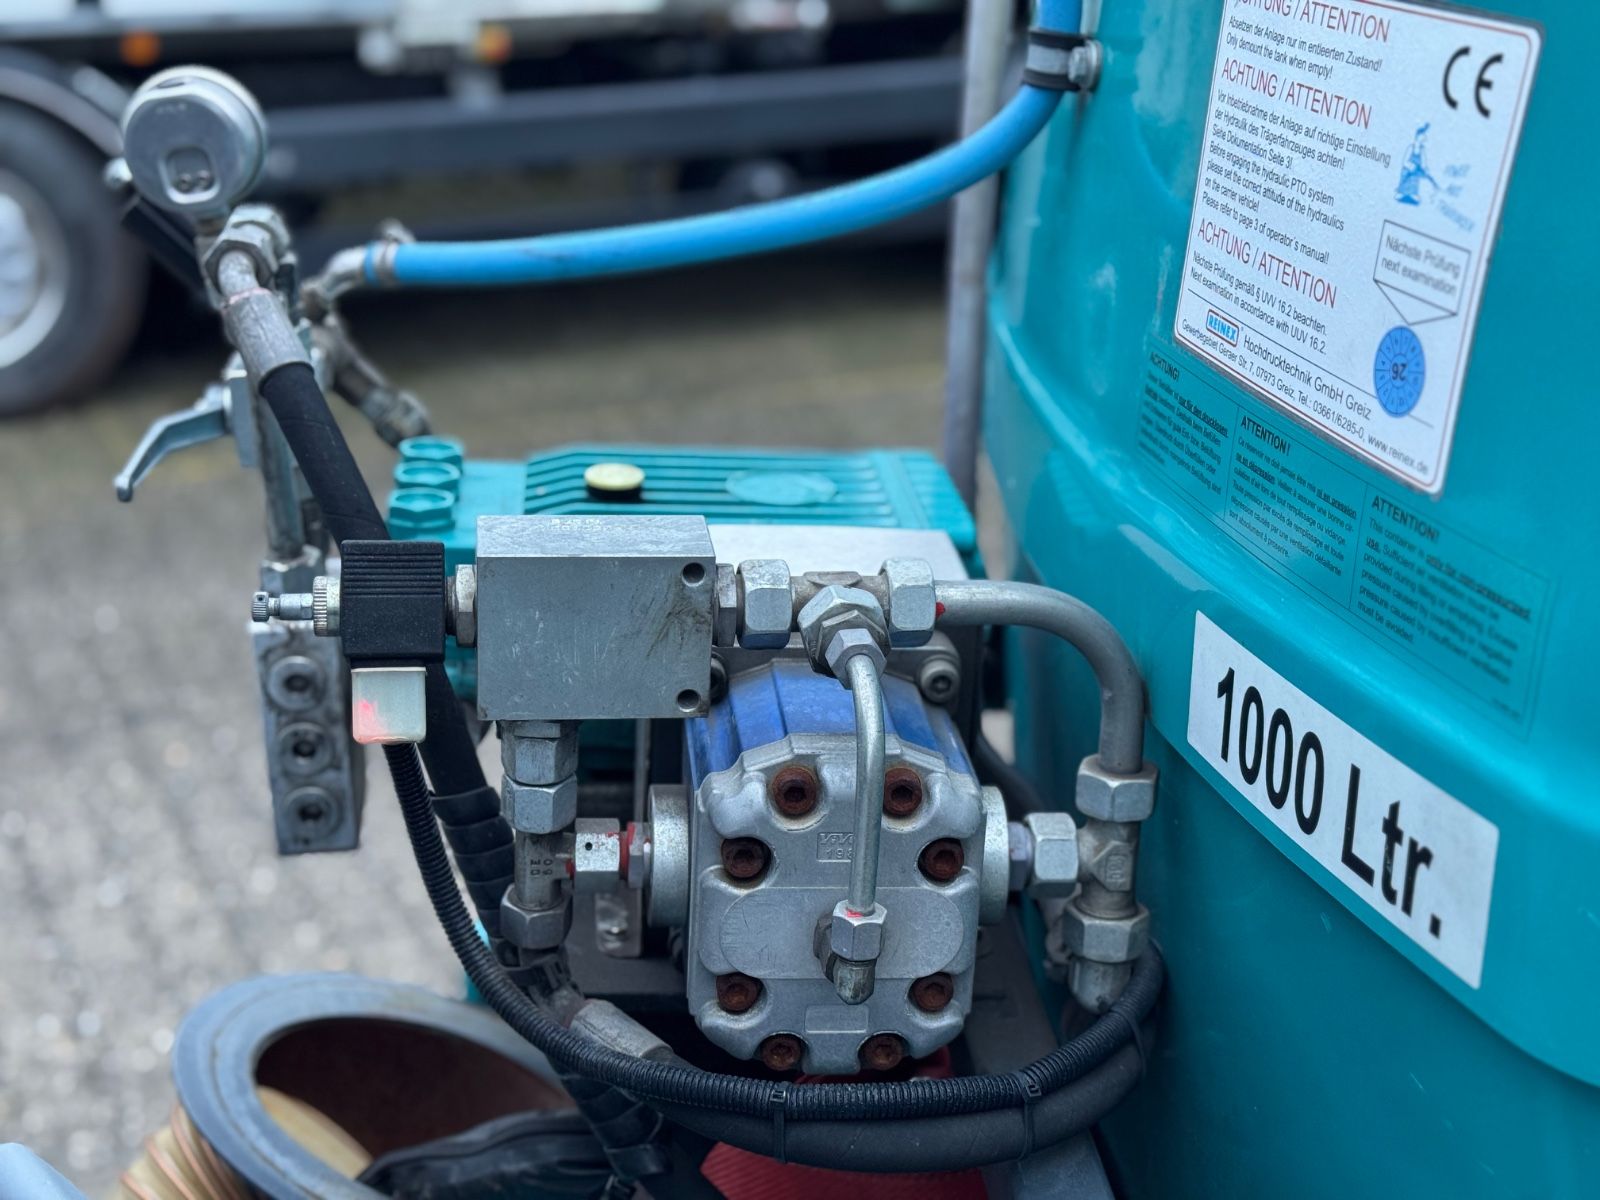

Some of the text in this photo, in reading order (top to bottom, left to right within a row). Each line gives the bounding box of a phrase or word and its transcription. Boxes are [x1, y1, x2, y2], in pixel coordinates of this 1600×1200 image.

[1229, 16, 1382, 72] Absetzen der Anlage nur im entleerten Zustand!
[1294, 0, 1301, 20] /
[1300, 0, 1391, 42] ATTENTION
[1226, 33, 1238, 51] Only
[1263, 46, 1273, 59] the
[1274, 50, 1288, 64] tank
[1289, 56, 1307, 70] when
[1308, 63, 1333, 81] empty!
[1442, 46, 1504, 118] CE
[1222, 57, 1372, 130] ACHTUNG / ATTENTION
[1215, 107, 1346, 170] der Hydraulik des Trägerfahrzeuges achten!
[1217, 90, 1391, 169] Vor Inbetriebnahme der Anlage auf richtige Einstellung
[1227, 131, 1268, 159] Dokumentation
[1268, 149, 1285, 166] Seite
[1286, 156, 1293, 170] 3!
[1205, 178, 1260, 212] on the carrier vehicle!
[1207, 159, 1223, 176] please
[1224, 169, 1232, 180] set
[1233, 171, 1242, 185] the
[1242, 178, 1262, 195] correct
[1286, 197, 1295, 209] of
[1294, 200, 1306, 215] the
[1307, 204, 1345, 232] hydraulics
[1210, 141, 1335, 207] Before engaging the hydraulic PTO system
[1202, 191, 1219, 210] Please
[1220, 203, 1232, 217] refer
[1233, 208, 1238, 220] to
[1238, 214, 1253, 230] page
[1254, 219, 1259, 231] 3
[1259, 223, 1266, 235] of
[1198, 217, 1337, 309] ACHTUNG / ATTENTION
[1381, 258, 1457, 296] next examination
[1385, 235, 1461, 280] Nächste Prüfung
[1191, 267, 1326, 355] Next examination in accordance with UUV 16.2.
[1193, 252, 1213, 273] Nächste
[1213, 264, 1234, 288] Prüfung
[1261, 291, 1277, 308] UVV
[1277, 300, 1292, 317] 16.2
[1293, 308, 1326, 336] beachten.
[1209, 315, 1237, 342] REINEX
[1244, 335, 1313, 386] Hochdrucktechnik
[1314, 375, 1344, 404] GmbH
[1345, 393, 1372, 421] Greiz
[1238, 355, 1247, 370] Str.
[1256, 366, 1276, 387] 07973
[1277, 378, 1296, 401] Greiz,
[1297, 390, 1312, 409] Tel.:
[1313, 400, 1366, 443] 03661/6285-0,
[1368, 435, 1428, 476] www.reinex.de
[1217, 667, 1441, 939] 1000 Ltr.
